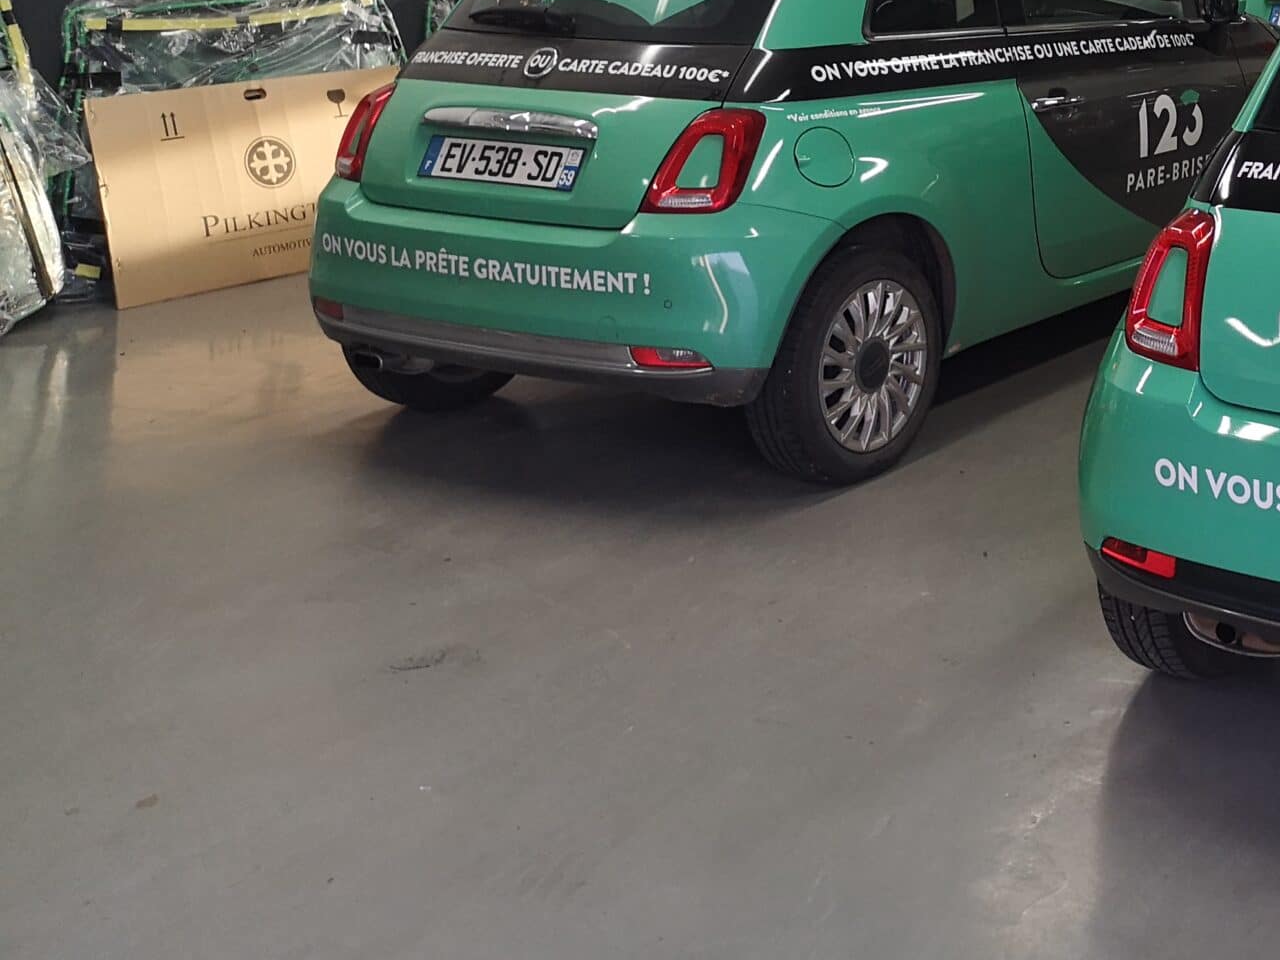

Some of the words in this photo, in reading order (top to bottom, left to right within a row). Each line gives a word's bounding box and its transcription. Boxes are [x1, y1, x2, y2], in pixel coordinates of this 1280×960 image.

[412, 50, 467, 66] FRANCHISE
[466, 52, 523, 69] OFFERTE
[529, 55, 550, 69] OU
[558, 58, 608, 75] CARTE
[607, 61, 677, 79] CADEAU
[811, 63, 842, 83] ON
[841, 58, 889, 79] VOUS
[890, 53, 939, 73] OFFRE
[939, 52, 960, 69] LA
[959, 45, 1034, 67] FRANCHISE
[1034, 41, 1053, 59] OU
[1053, 40, 1080, 57] UNE
[1079, 37, 1115, 55] CARTE
[1115, 33, 1157, 52] CADEAU
[1156, 34, 1171, 49] DE
[1139, 94, 1203, 158] 123
[558, 170, 576, 186] 59
[322, 232, 342, 256] ON
[344, 238, 387, 265] VOUS
[391, 246, 411, 269] LA
[415, 247, 469, 277] PRÊTE
[473, 258, 637, 294] GRATUITEMENT
[643, 272, 651, 295] !
[1154, 458, 1198, 494] ON
